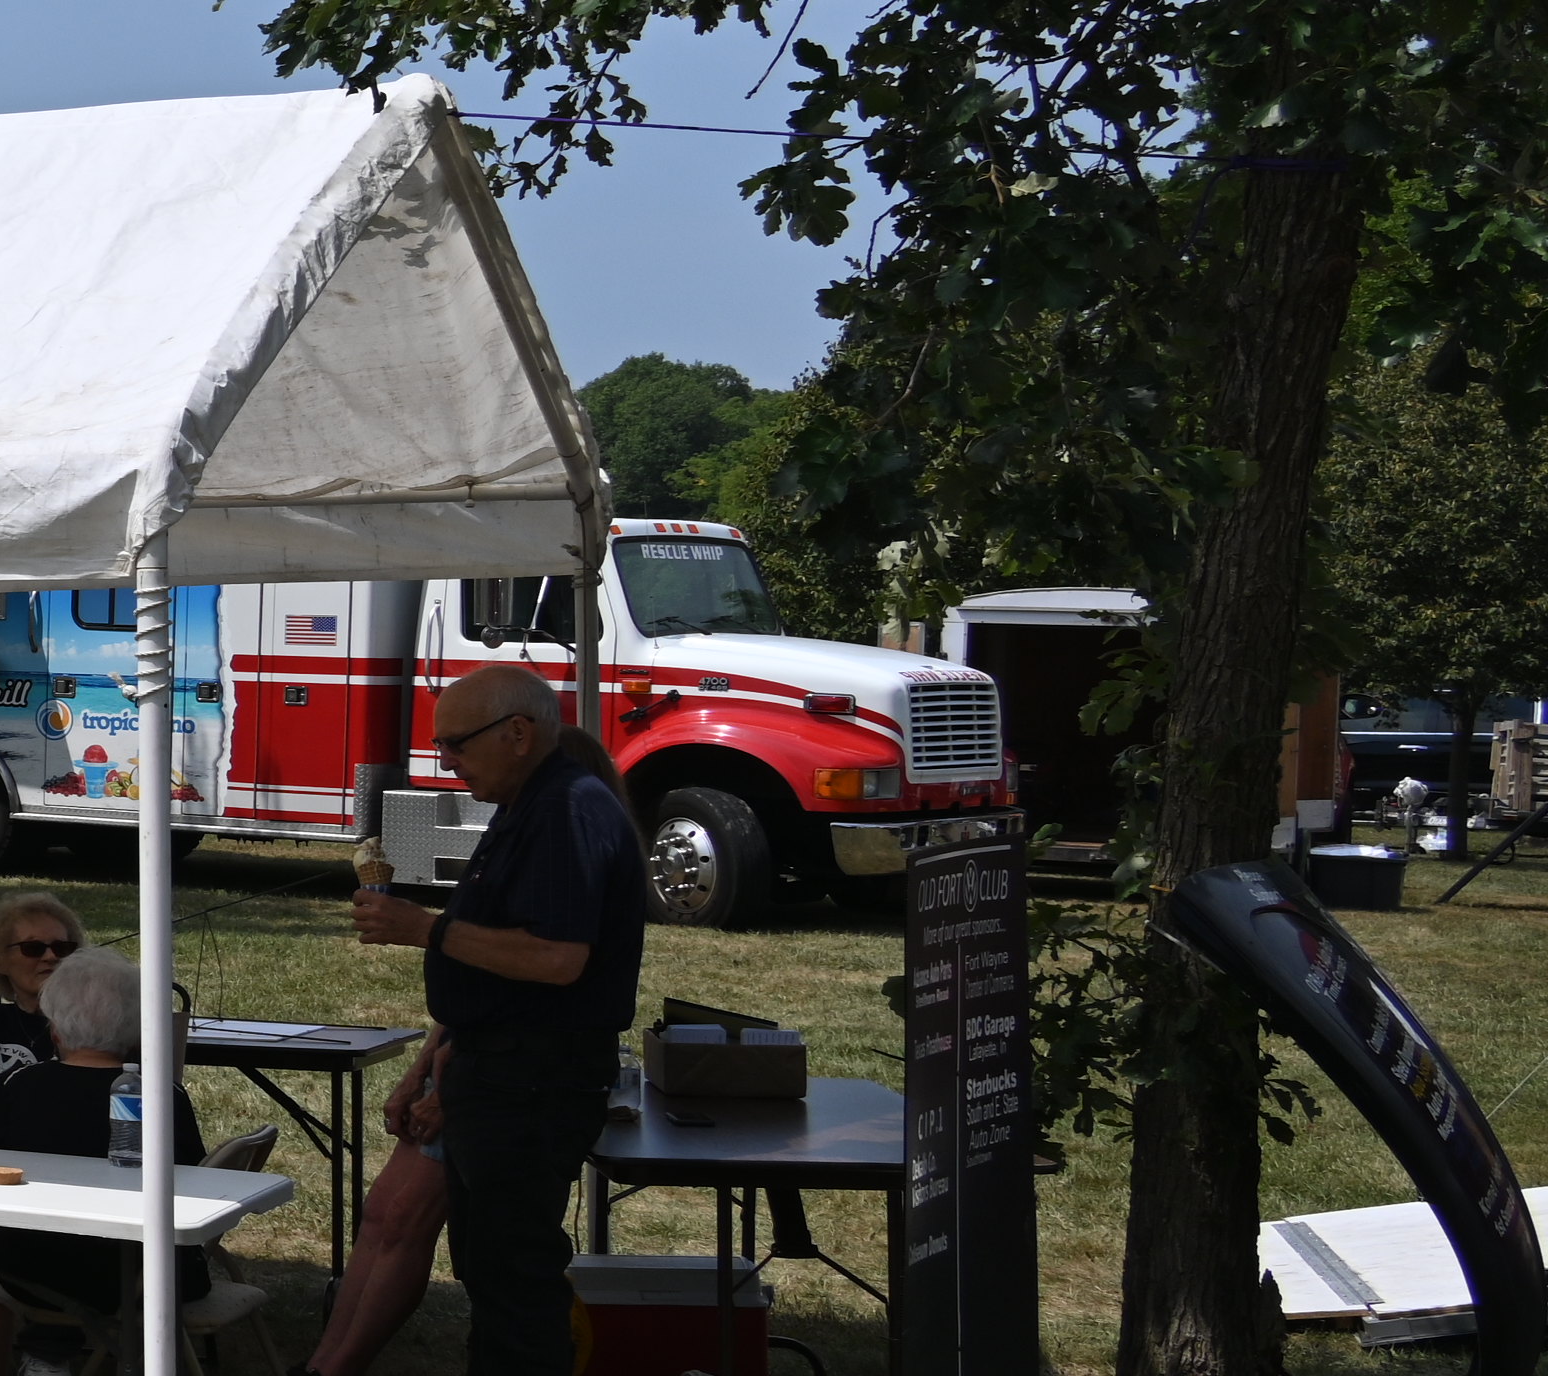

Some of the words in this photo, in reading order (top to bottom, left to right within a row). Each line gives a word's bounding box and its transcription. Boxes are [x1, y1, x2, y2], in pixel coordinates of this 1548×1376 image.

[641, 544, 689, 560] RESCUE
[690, 545, 724, 560] WHIP
[918, 877, 936, 912] OLD
[937, 872, 963, 908] FORT
[979, 869, 1009, 901] CLUB
[965, 954, 981, 971] Fort
[980, 951, 1009, 969] Wayne
[965, 1015, 983, 1040] BDC
[984, 1014, 1015, 1038] Garage
[966, 1068, 1017, 1101] Starbucks
[968, 1129, 987, 1151] Auto
[989, 1124, 1011, 1148] Zone
